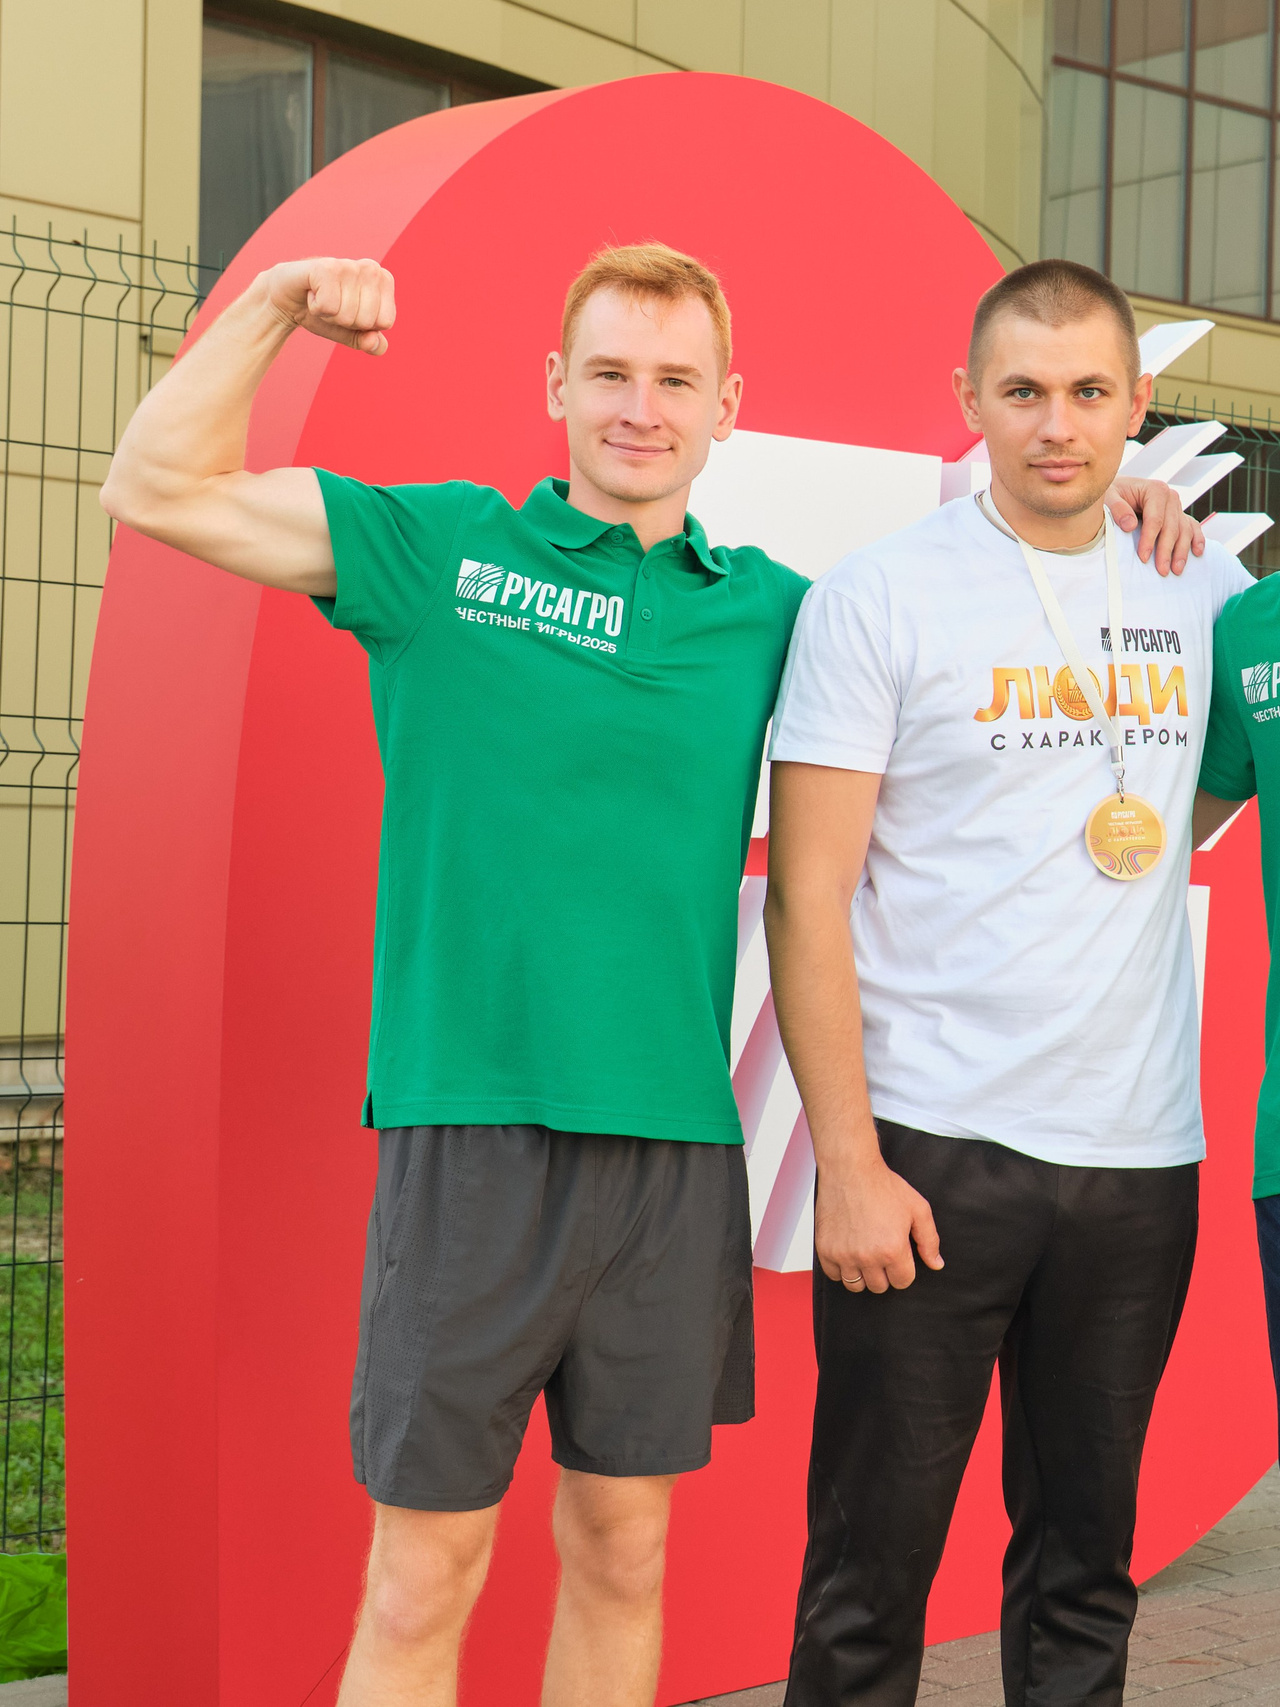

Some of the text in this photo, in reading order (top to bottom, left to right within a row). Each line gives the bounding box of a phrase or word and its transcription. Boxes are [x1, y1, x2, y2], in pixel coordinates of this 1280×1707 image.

[500, 571, 625, 637] РУСАГРО
[455, 606, 532, 631] ЧЕСТНЫЕ
[1122, 627, 1182, 655] РУСАГРО
[973, 663, 1189, 725] ЛЮДИ
[990, 728, 1188, 751] С ХАРАКЕРОМ
